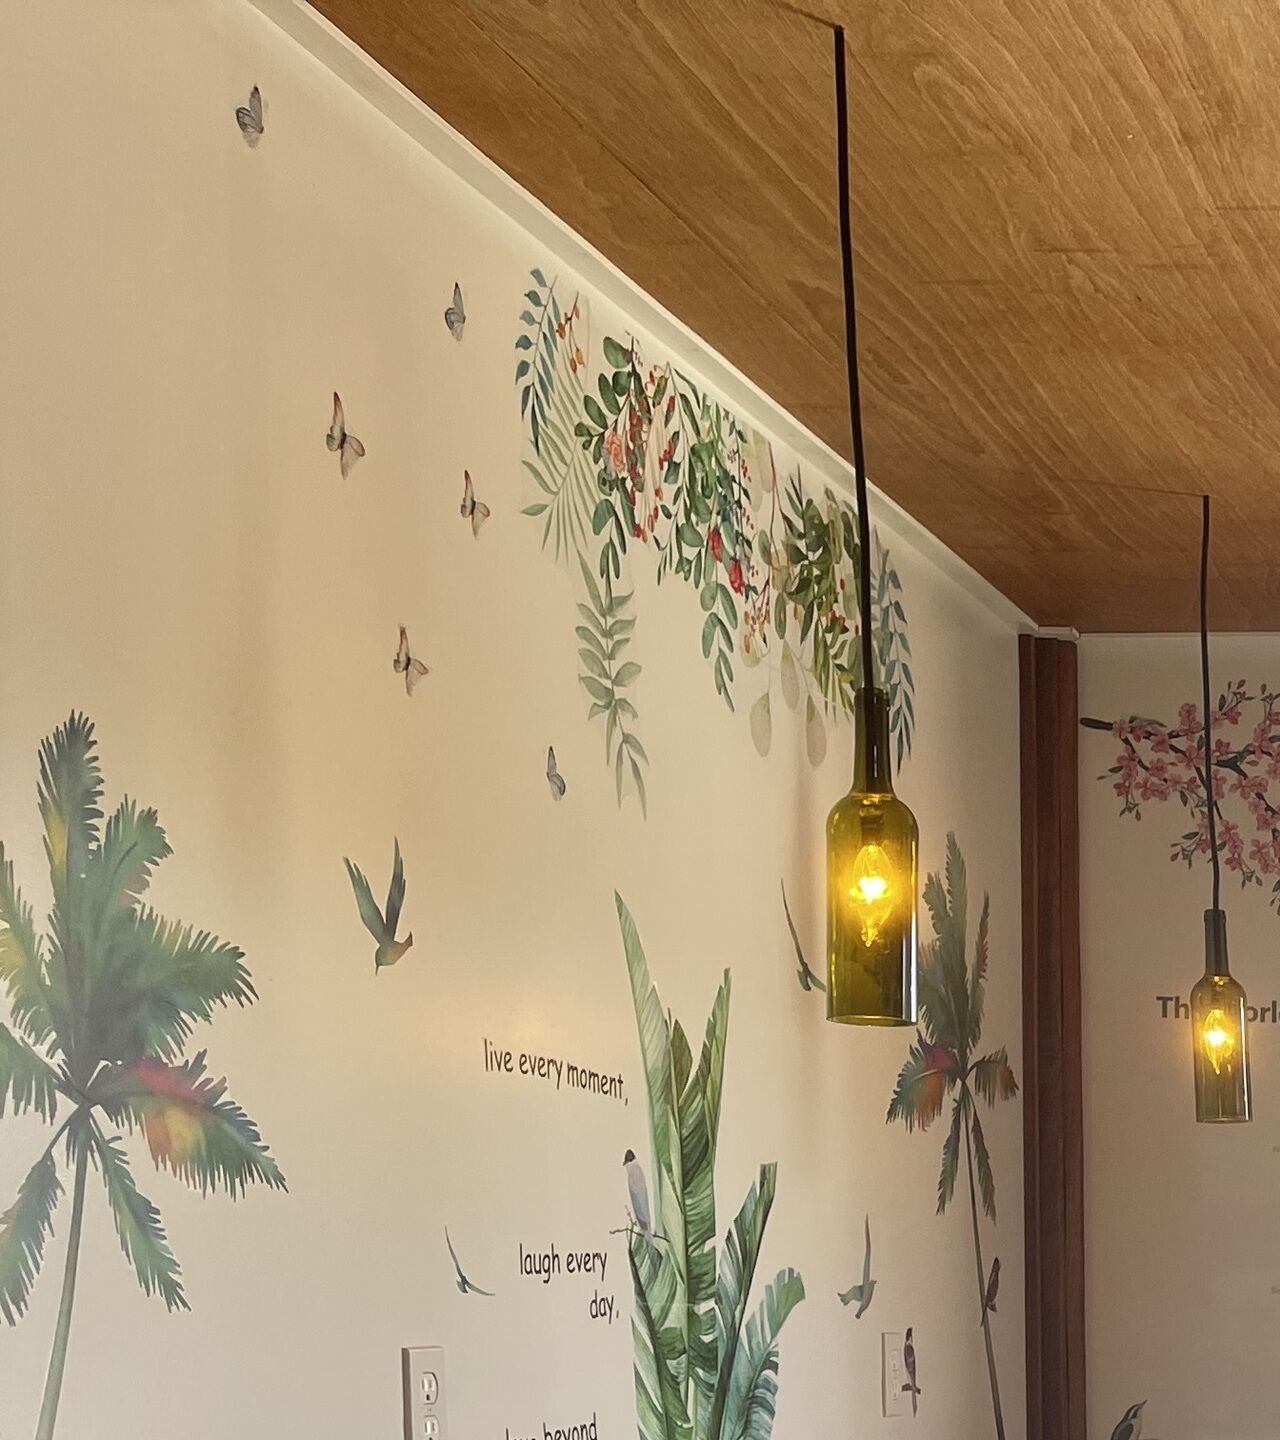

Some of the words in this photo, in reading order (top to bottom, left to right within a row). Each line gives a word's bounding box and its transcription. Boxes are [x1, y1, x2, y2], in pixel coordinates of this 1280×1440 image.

[1156, 996, 1190, 1019] Th
[483, 1038, 514, 1073] live
[518, 1050, 563, 1090] every
[567, 1061, 629, 1106] moment,
[519, 1243, 560, 1284] laugh
[566, 1247, 608, 1280] every
[589, 1290, 620, 1323] day,
